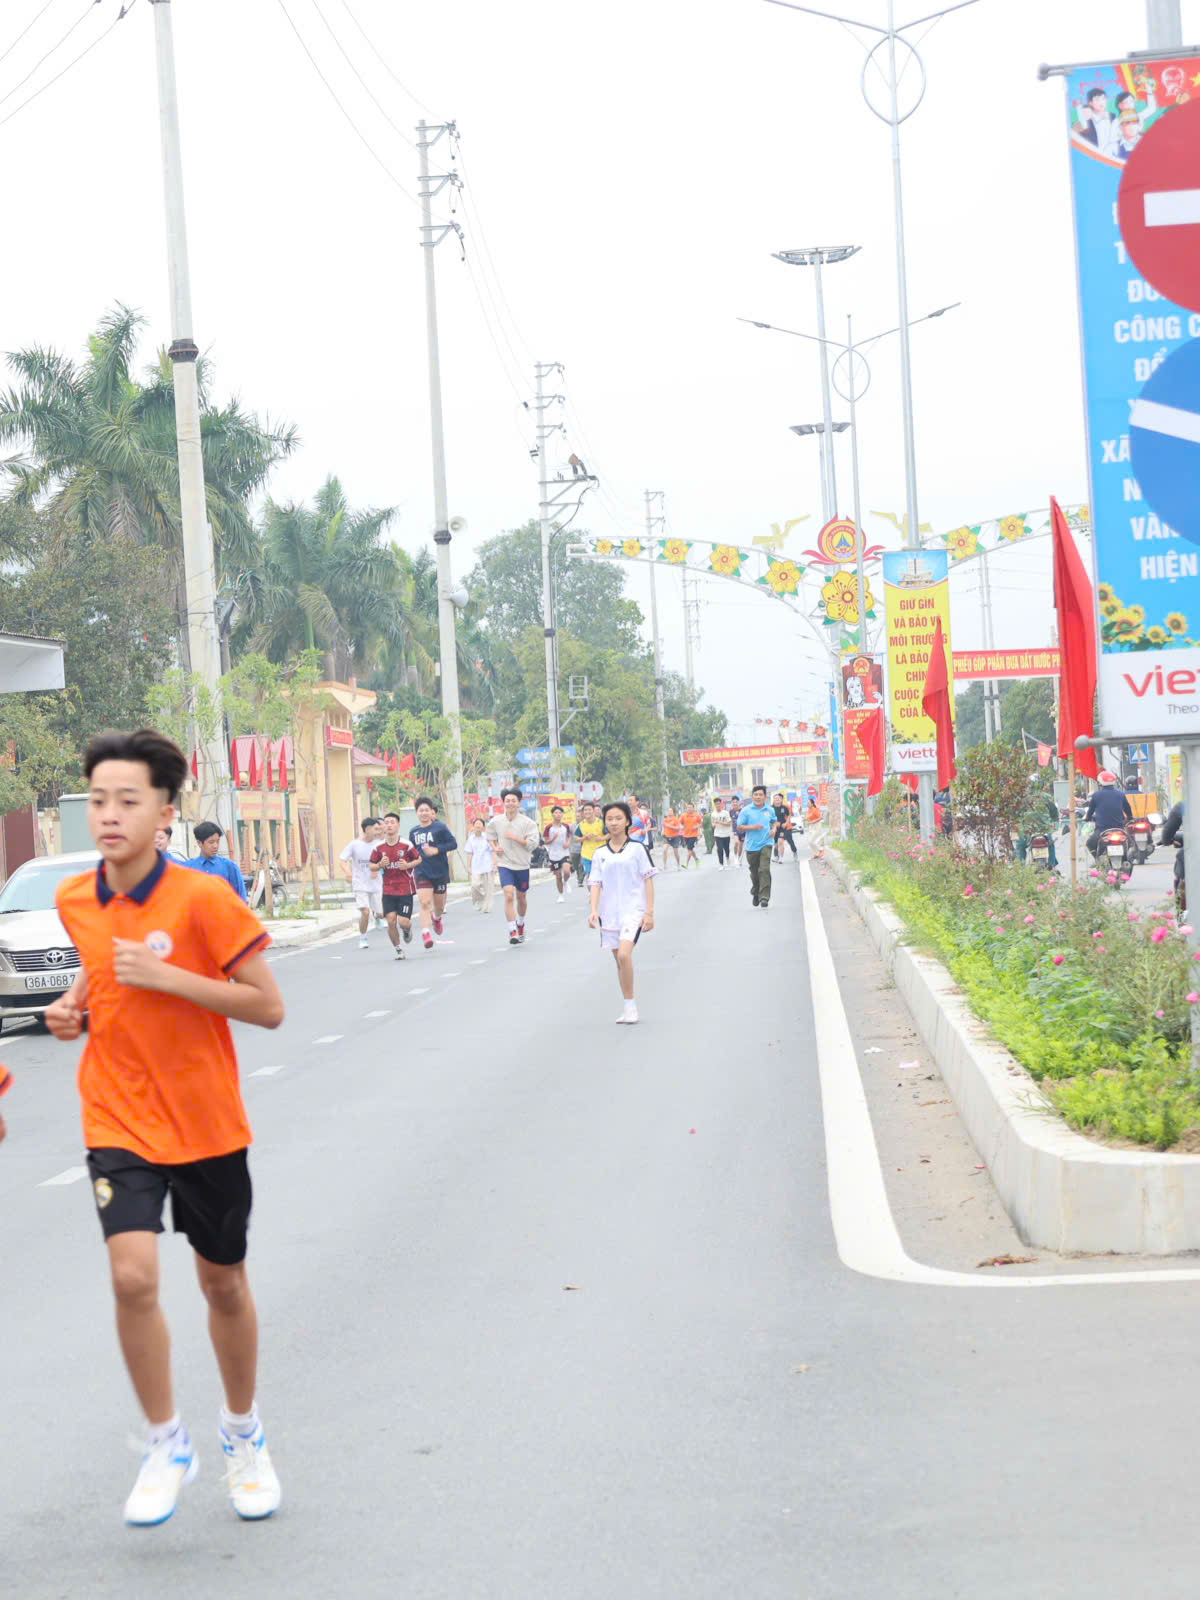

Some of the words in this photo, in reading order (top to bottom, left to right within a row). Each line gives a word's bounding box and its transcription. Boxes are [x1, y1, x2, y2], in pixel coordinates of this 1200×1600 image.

[1114, 314, 1181, 343] CÔNG
[1140, 550, 1198, 583] HIỆN
[1122, 665, 1200, 697] vie
[898, 748, 935, 759] viett
[414, 831, 434, 845] USA
[28, 975, 76, 988] 36A-068.7
